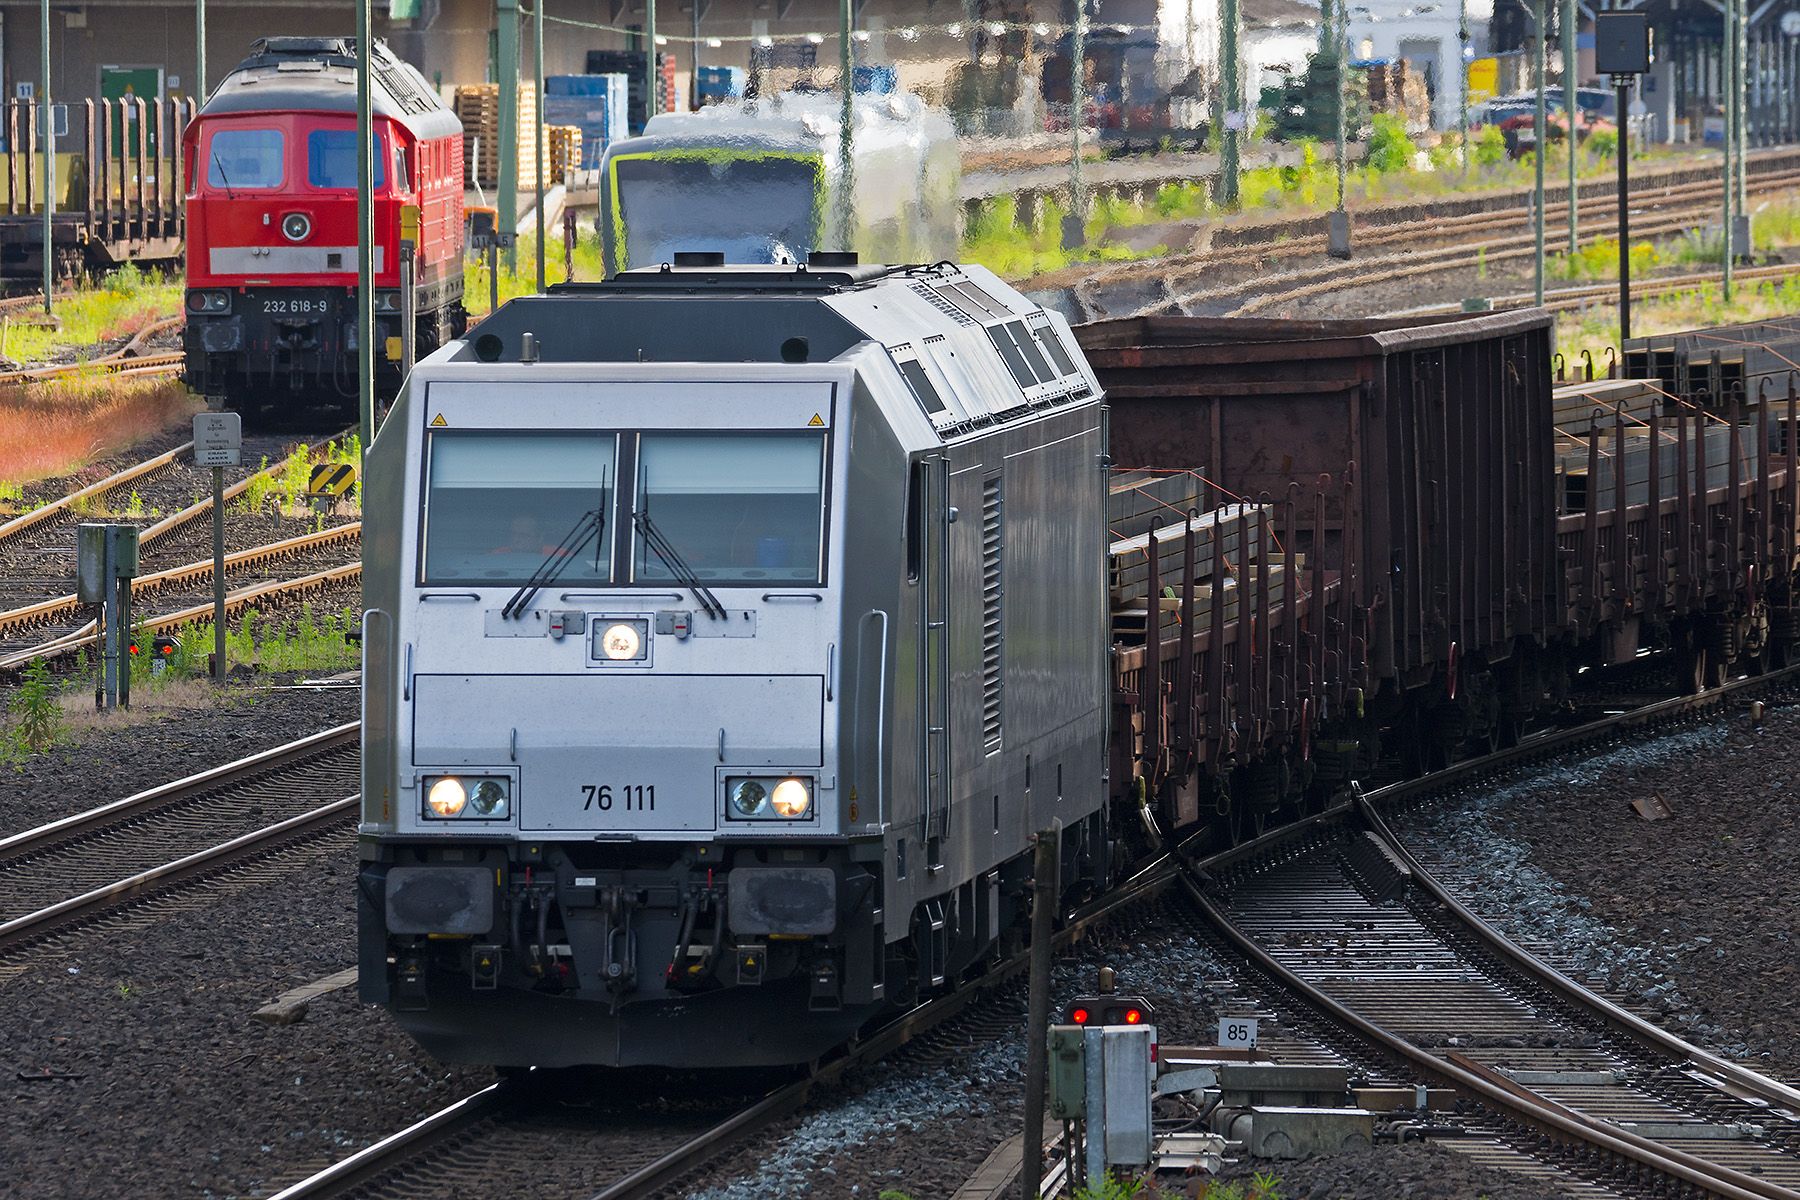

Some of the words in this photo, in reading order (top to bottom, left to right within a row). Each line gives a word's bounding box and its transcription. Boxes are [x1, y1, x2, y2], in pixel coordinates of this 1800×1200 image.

[19, 85, 31, 96] 11
[263, 300, 287, 313] 232
[290, 300, 327, 313] 618-9
[581, 784, 613, 811] 76
[623, 784, 655, 811] 111
[1227, 1024, 1248, 1041] 85
